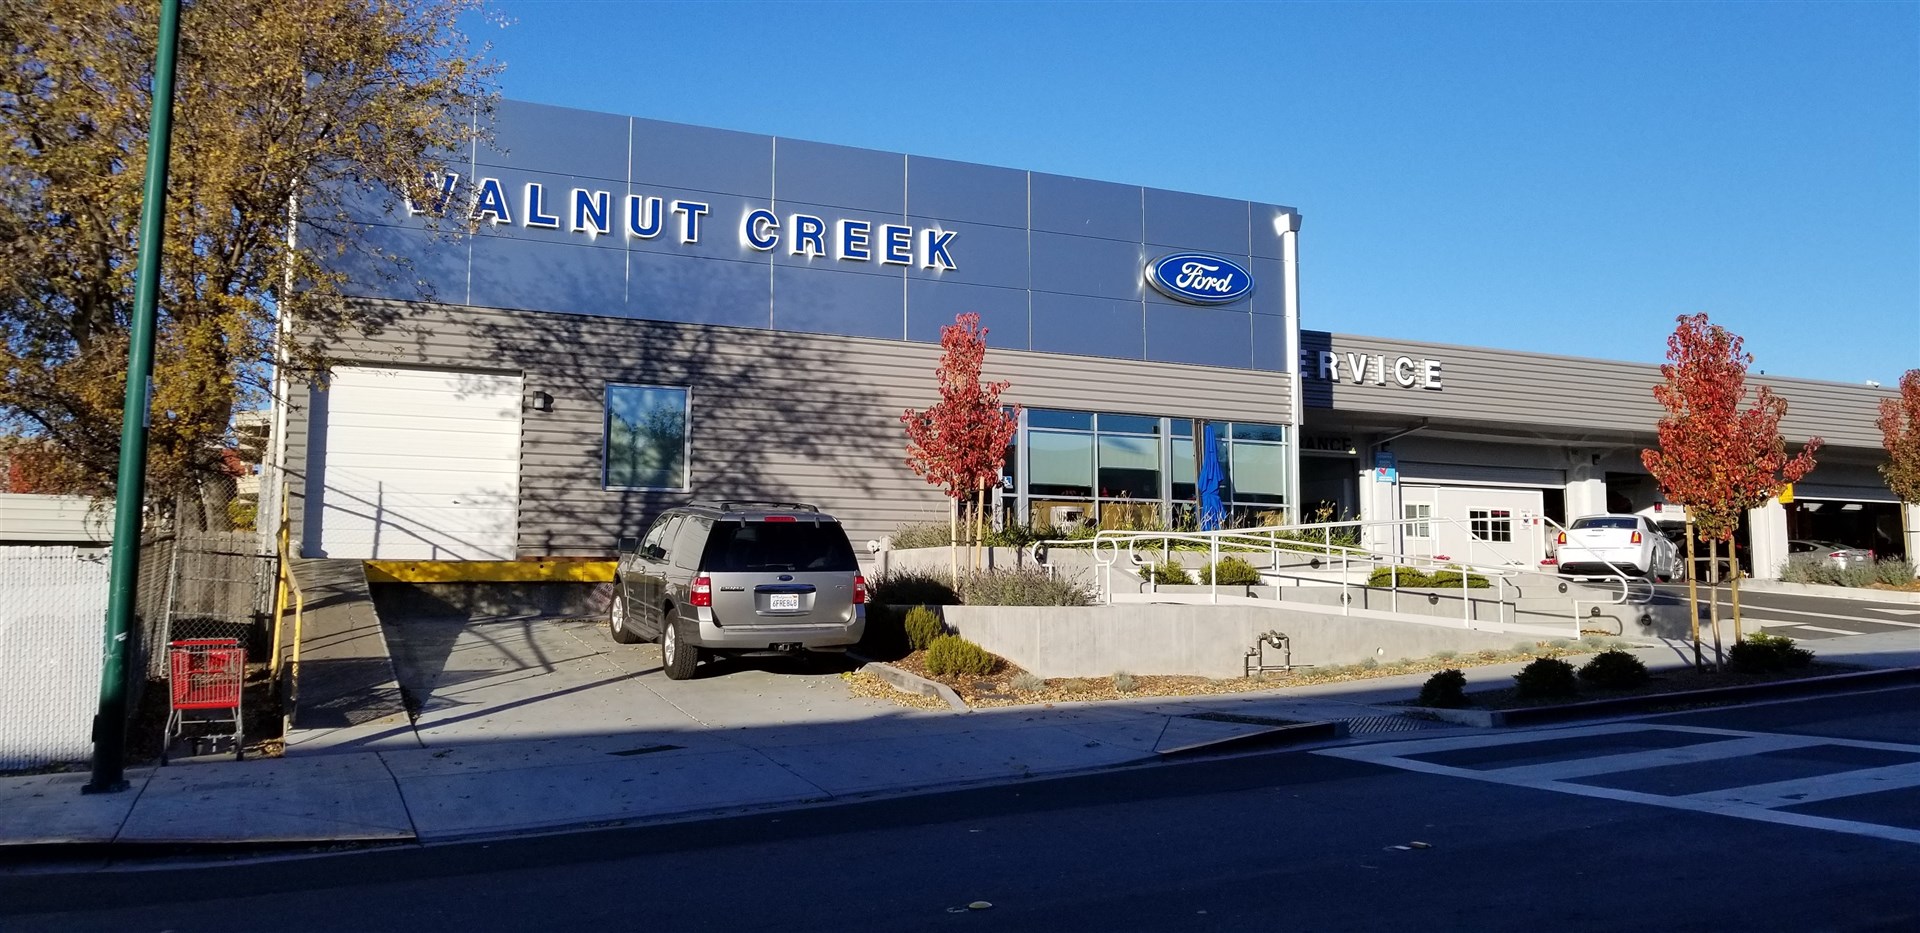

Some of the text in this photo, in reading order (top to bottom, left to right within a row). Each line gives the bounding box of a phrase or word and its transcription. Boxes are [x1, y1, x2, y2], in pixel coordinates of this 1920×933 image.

[744, 209, 958, 270] CREEK
[1175, 261, 1233, 293] Ford
[1300, 349, 1442, 391] ERVICE
[1301, 436, 1352, 451] ANCE
